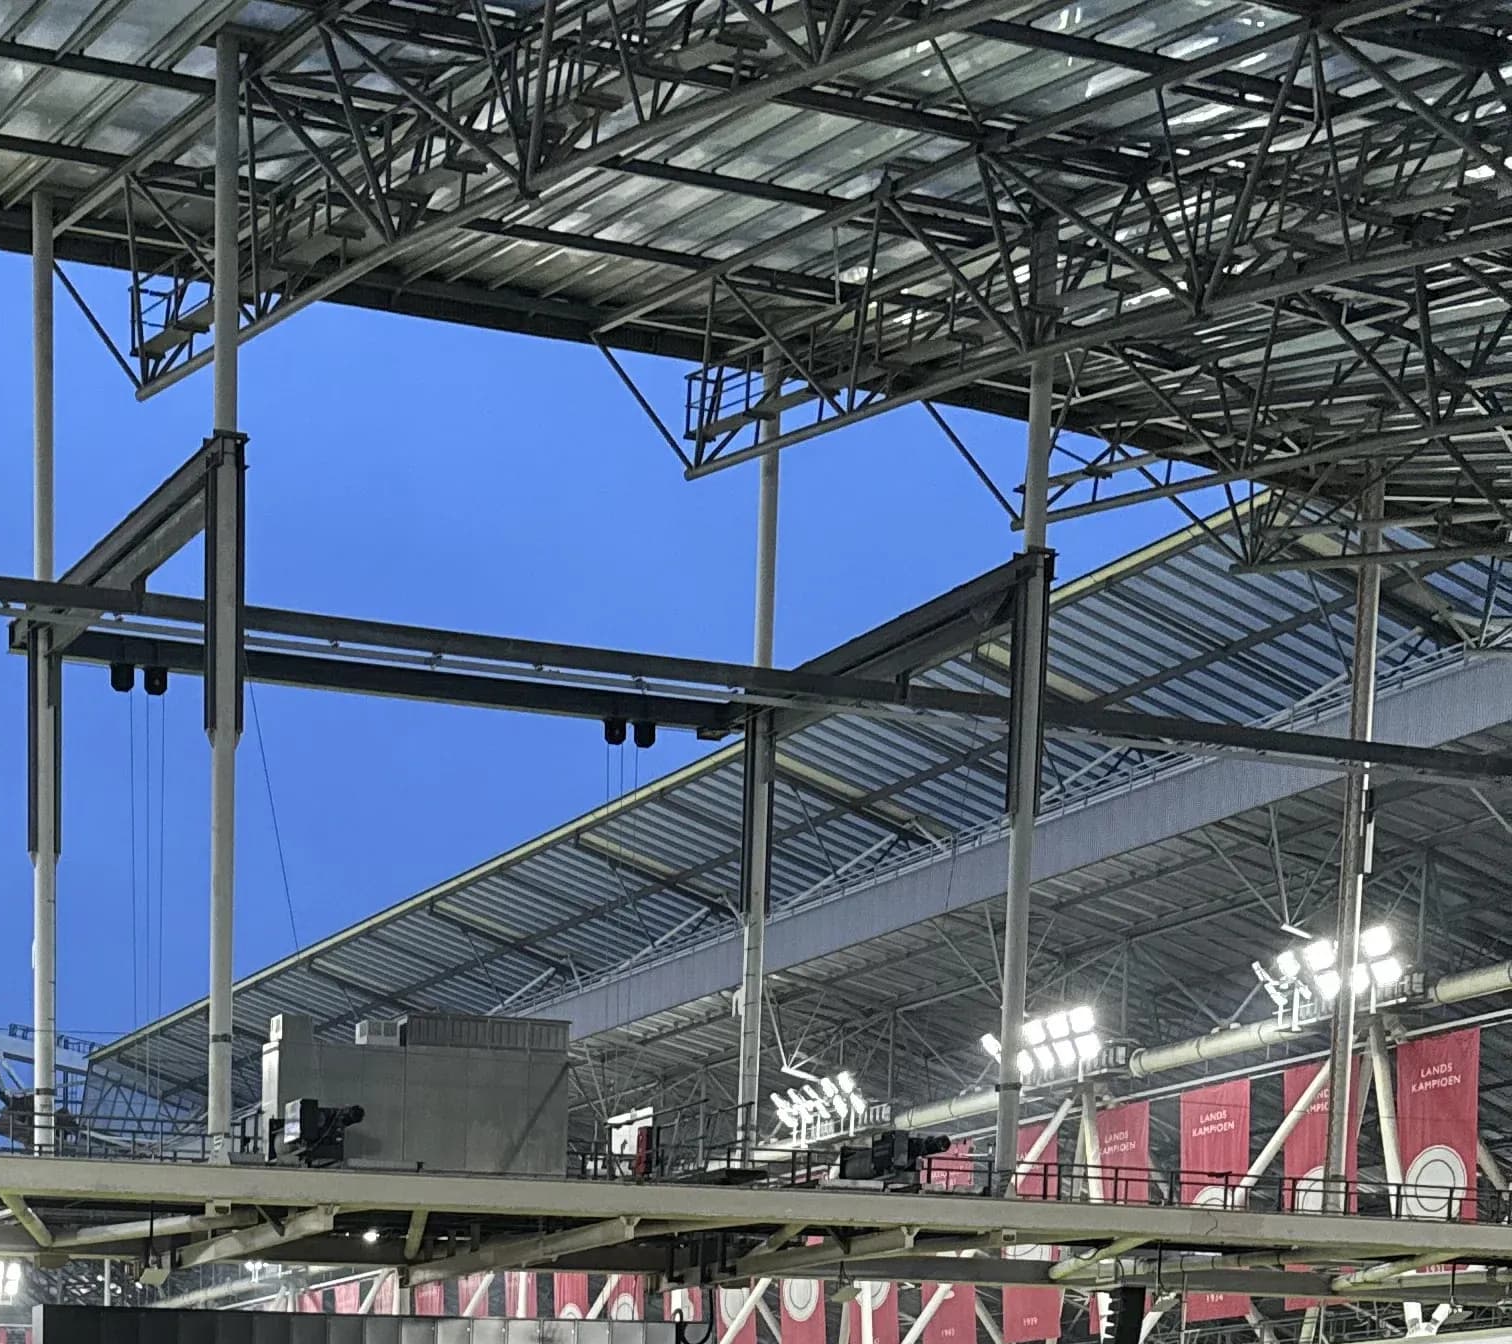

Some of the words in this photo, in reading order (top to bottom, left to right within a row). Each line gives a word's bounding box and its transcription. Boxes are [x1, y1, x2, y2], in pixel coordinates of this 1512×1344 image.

[1420, 1062, 1453, 1078] LANDS
[1411, 1075, 1461, 1093] KAMPIOEN
[1199, 1109, 1227, 1123] LANDS
[1104, 1130, 1129, 1143] LANDS
[1192, 1121, 1235, 1137] KAMPIOEN
